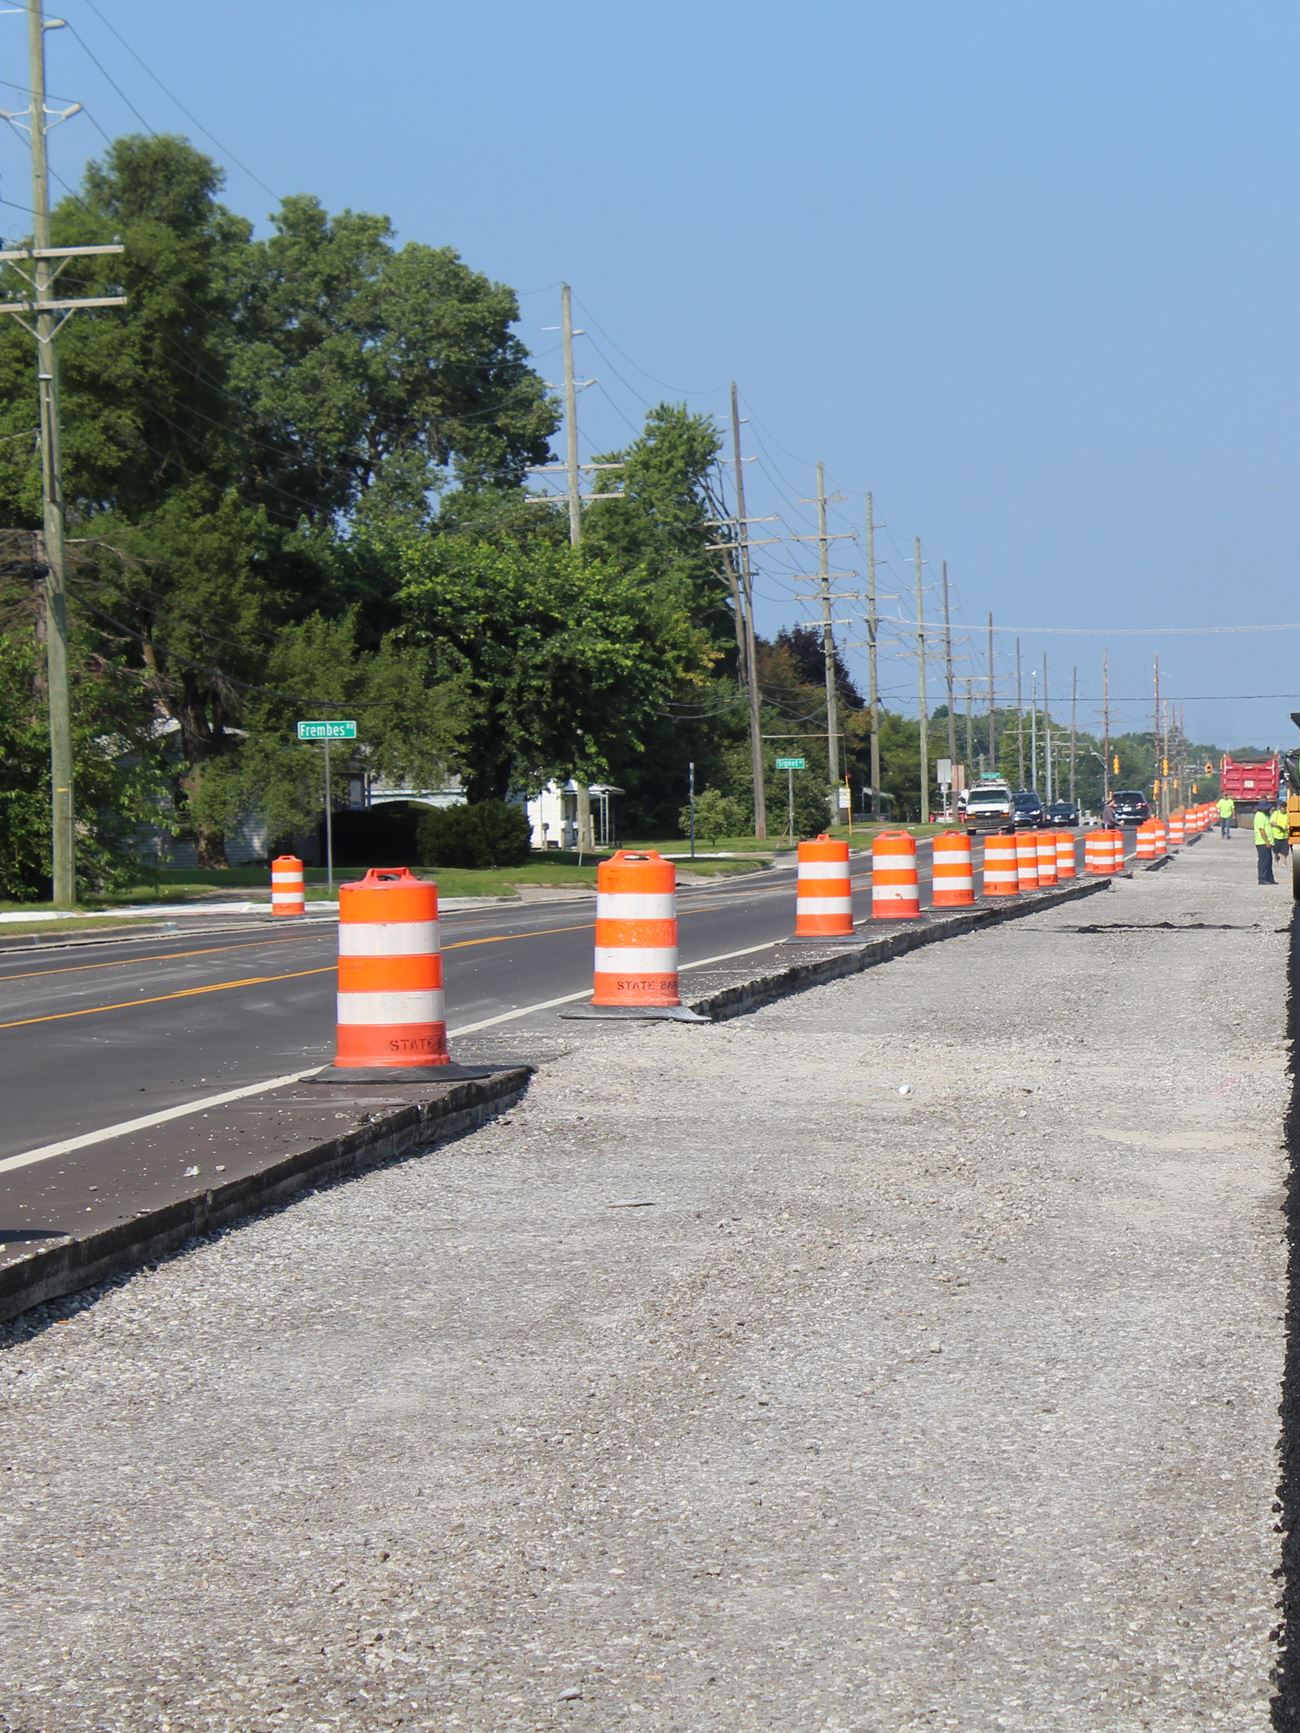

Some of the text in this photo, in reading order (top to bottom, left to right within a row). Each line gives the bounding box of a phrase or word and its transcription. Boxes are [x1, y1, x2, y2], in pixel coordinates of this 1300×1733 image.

[300, 723, 345, 737] Frembes
[617, 981, 655, 990] STATE
[390, 1039, 433, 1051] STATE
